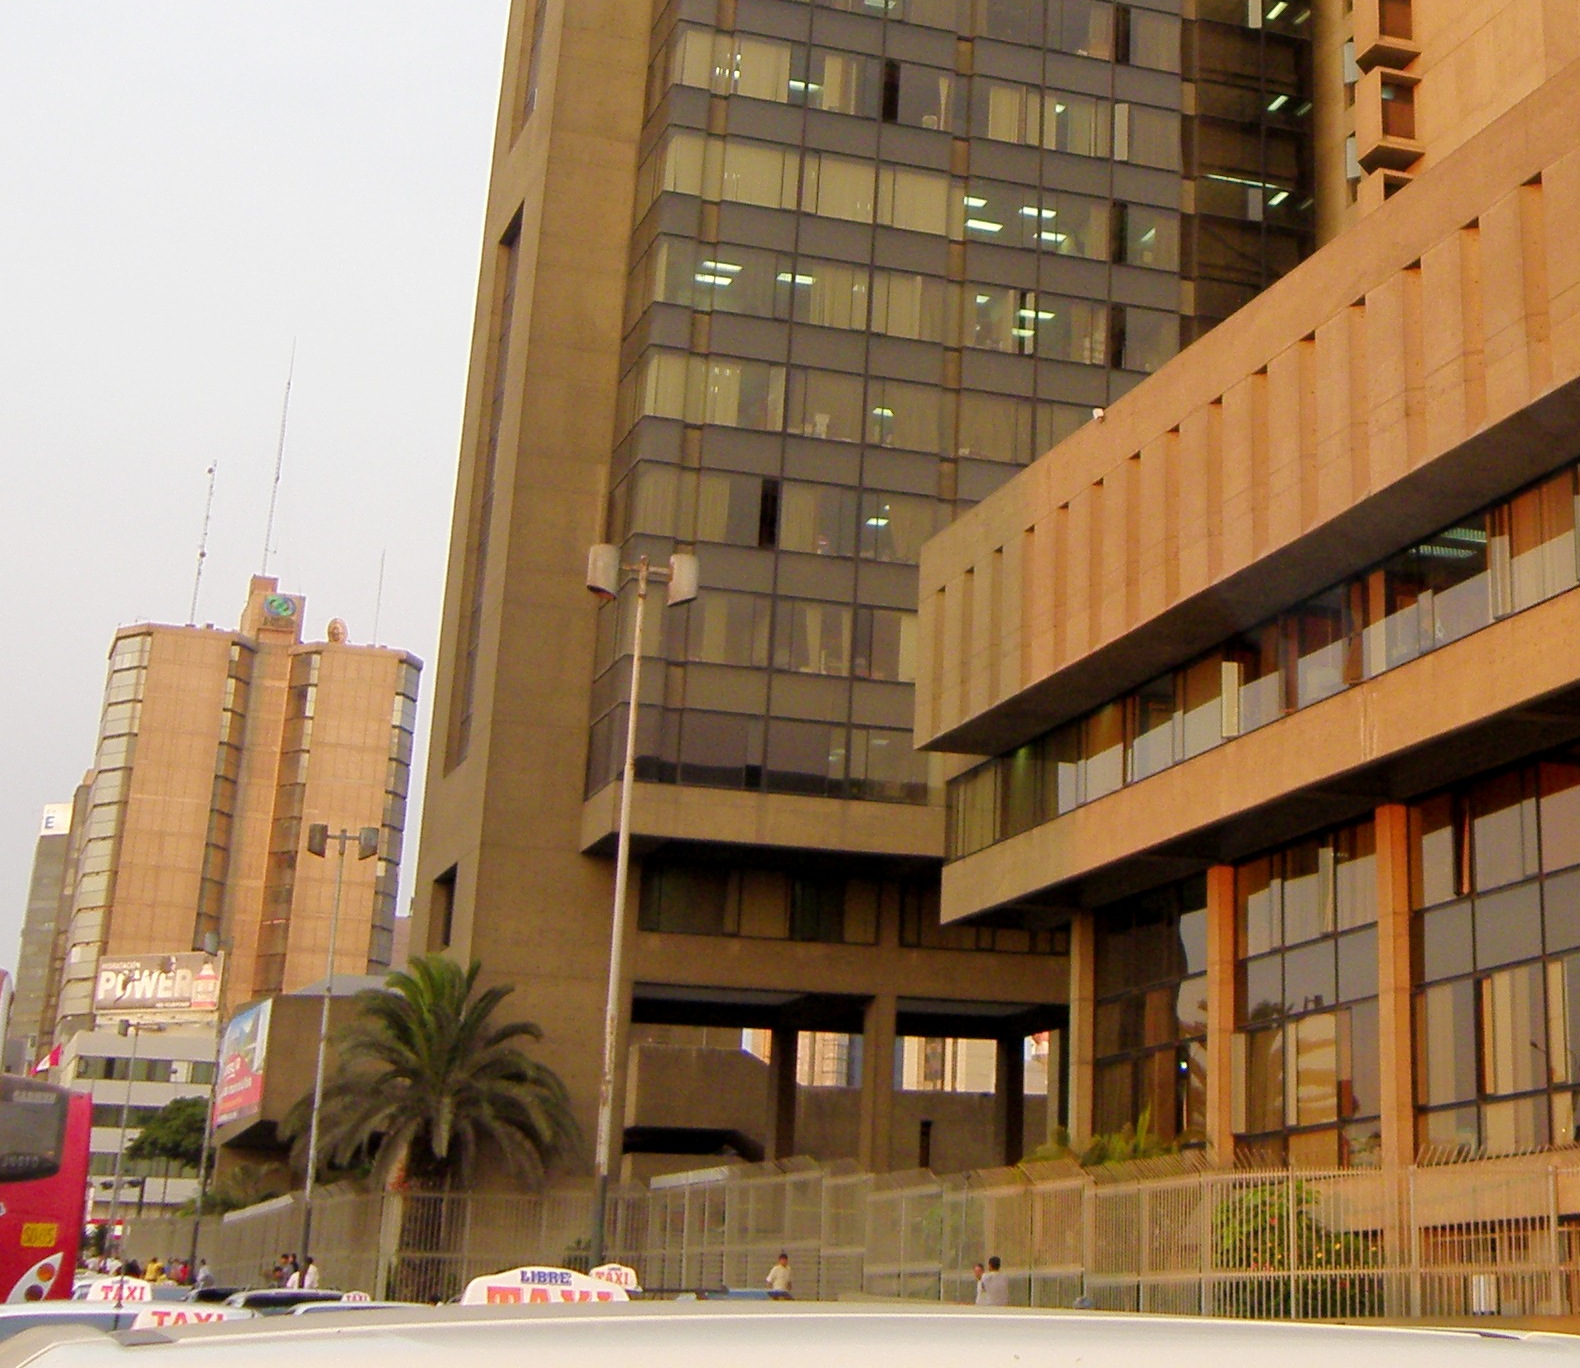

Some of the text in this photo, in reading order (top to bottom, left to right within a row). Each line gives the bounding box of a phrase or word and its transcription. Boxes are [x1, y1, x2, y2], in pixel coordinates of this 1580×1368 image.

[97, 969, 193, 1000] POWER
[520, 1270, 572, 1285] LIBRE
[595, 1272, 629, 1285] TAXI
[101, 1285, 145, 1300] TAXI
